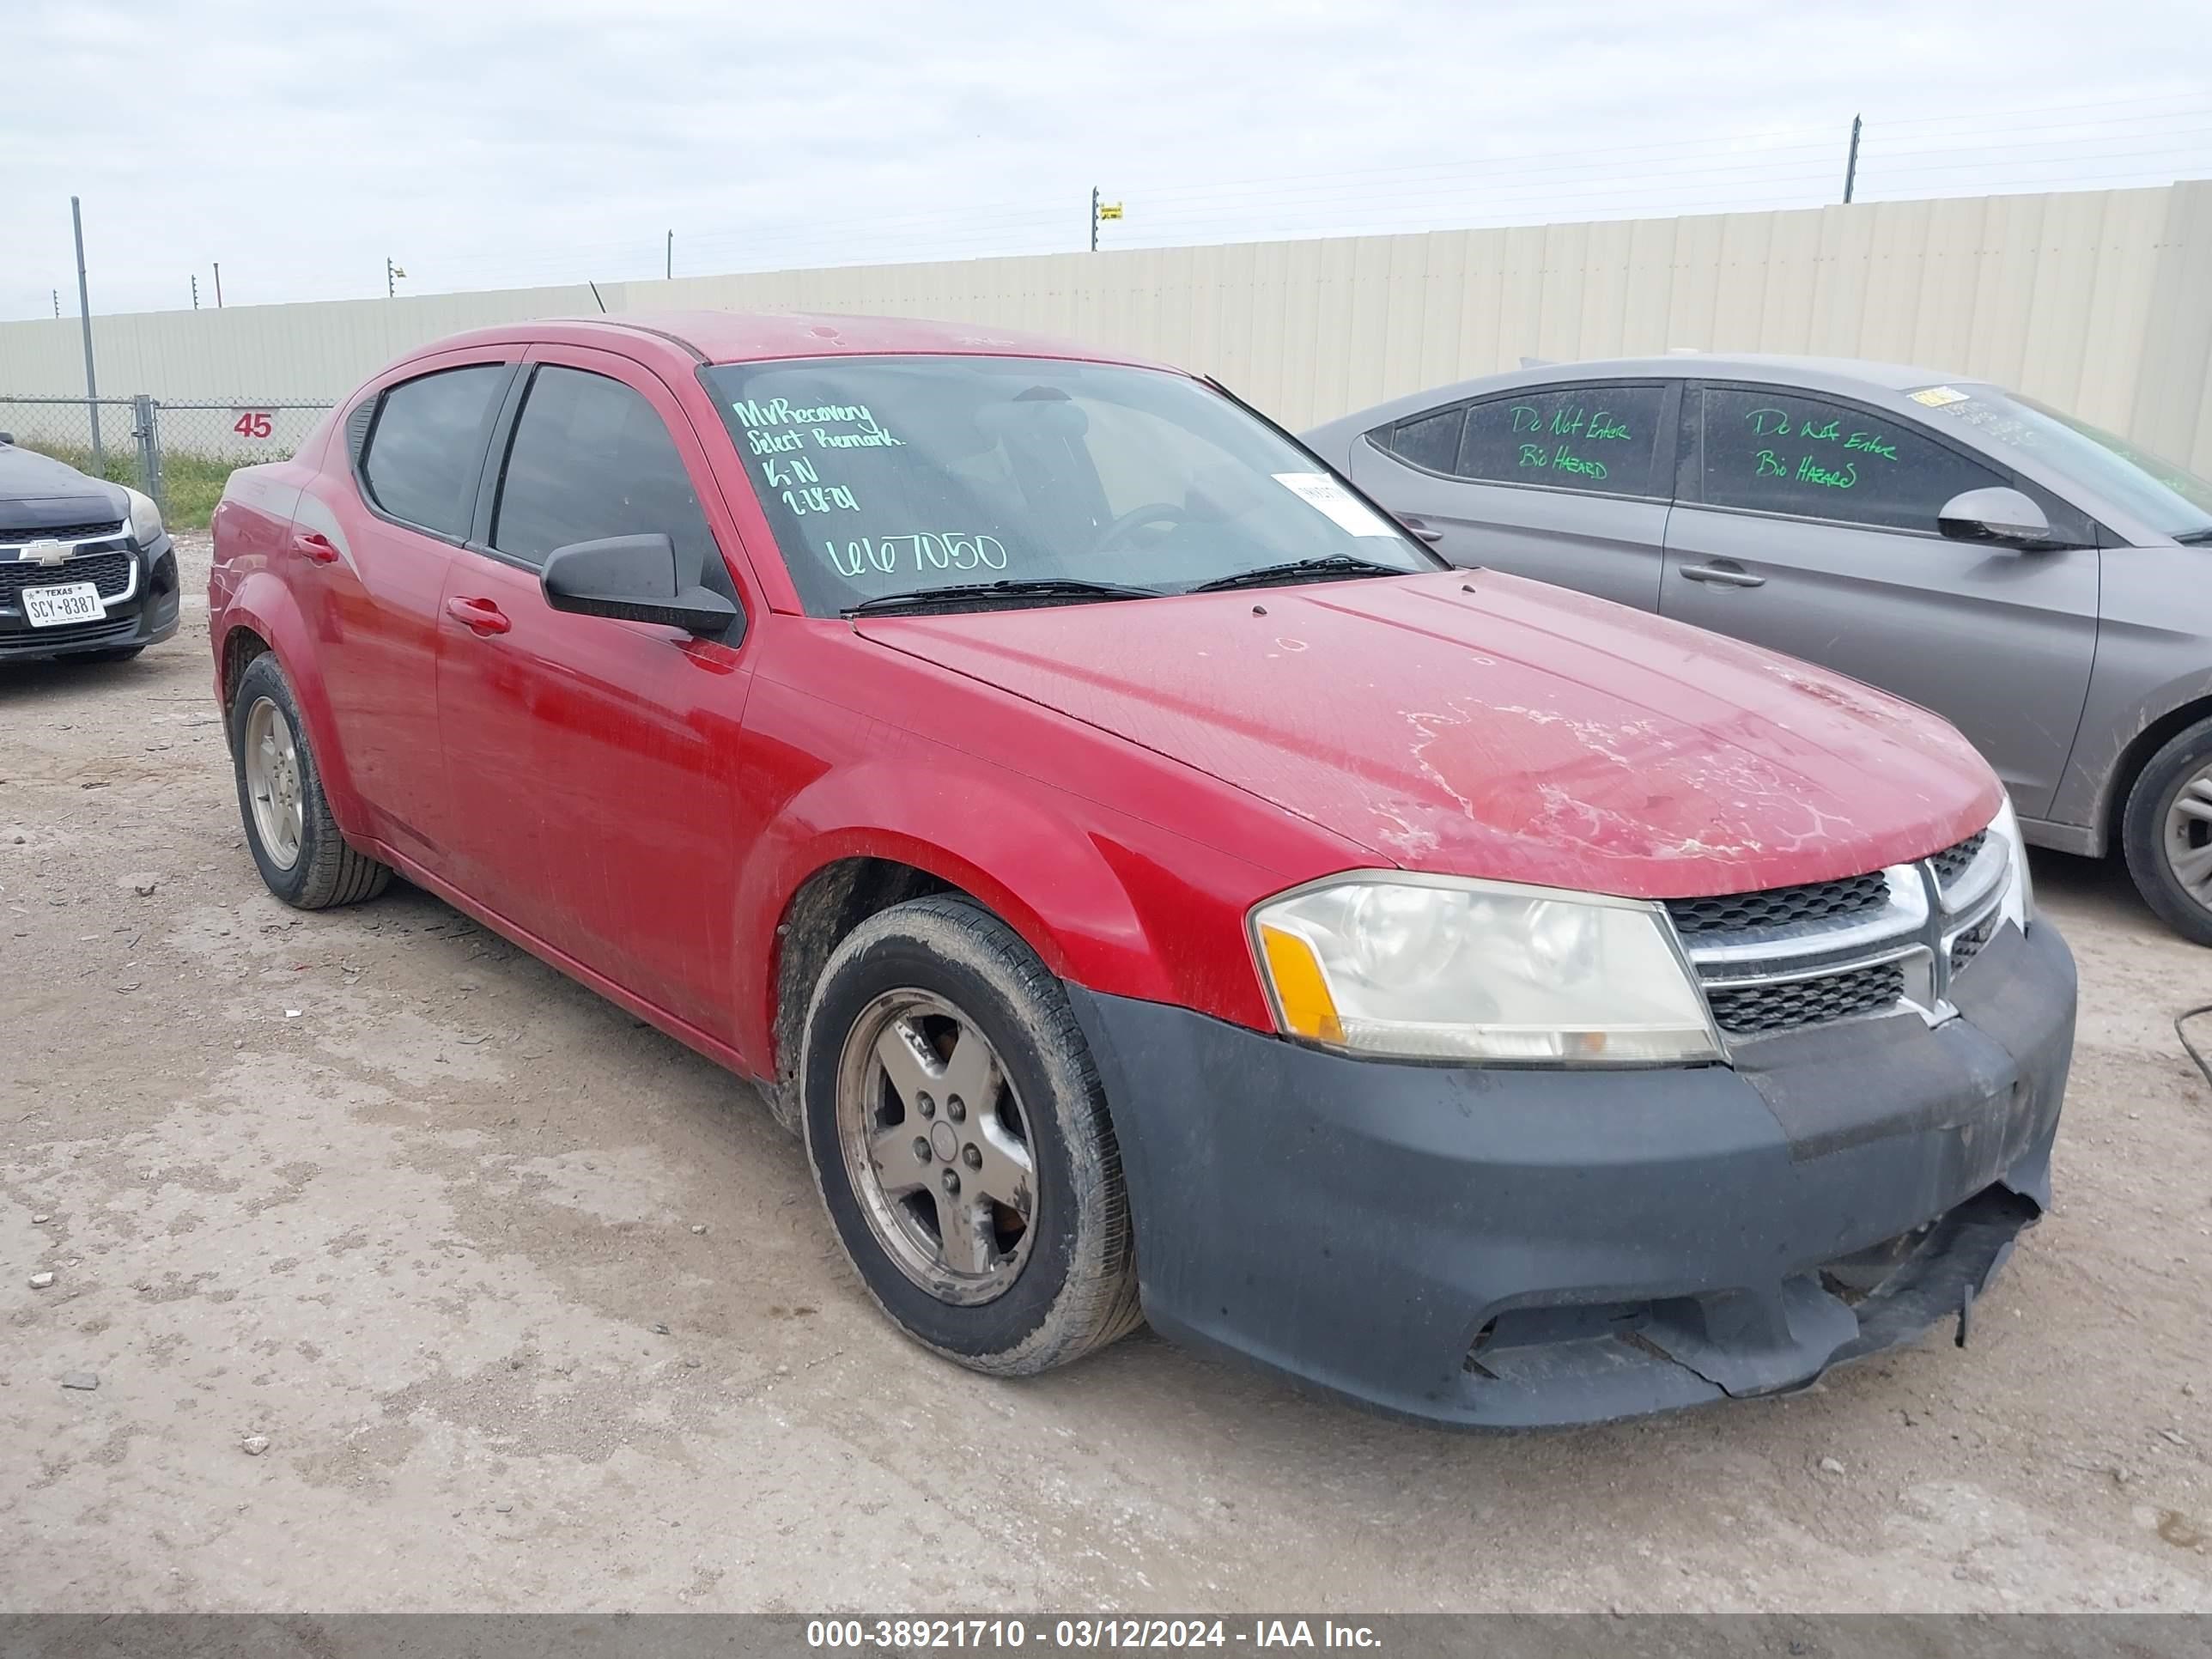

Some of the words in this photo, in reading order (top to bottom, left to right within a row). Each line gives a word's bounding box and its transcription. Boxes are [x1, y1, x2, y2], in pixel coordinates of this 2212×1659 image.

[234, 413, 271, 438] 45
[1510, 406, 1542, 432] Do
[1550, 405, 1583, 434] Not
[1746, 409, 1790, 435] Do
[746, 429, 804, 455] Select
[1519, 444, 1547, 467] Bio
[1756, 450, 1787, 477] Bio
[826, 532, 1007, 577] 667050
[45, 587, 73, 597] TEXAS
